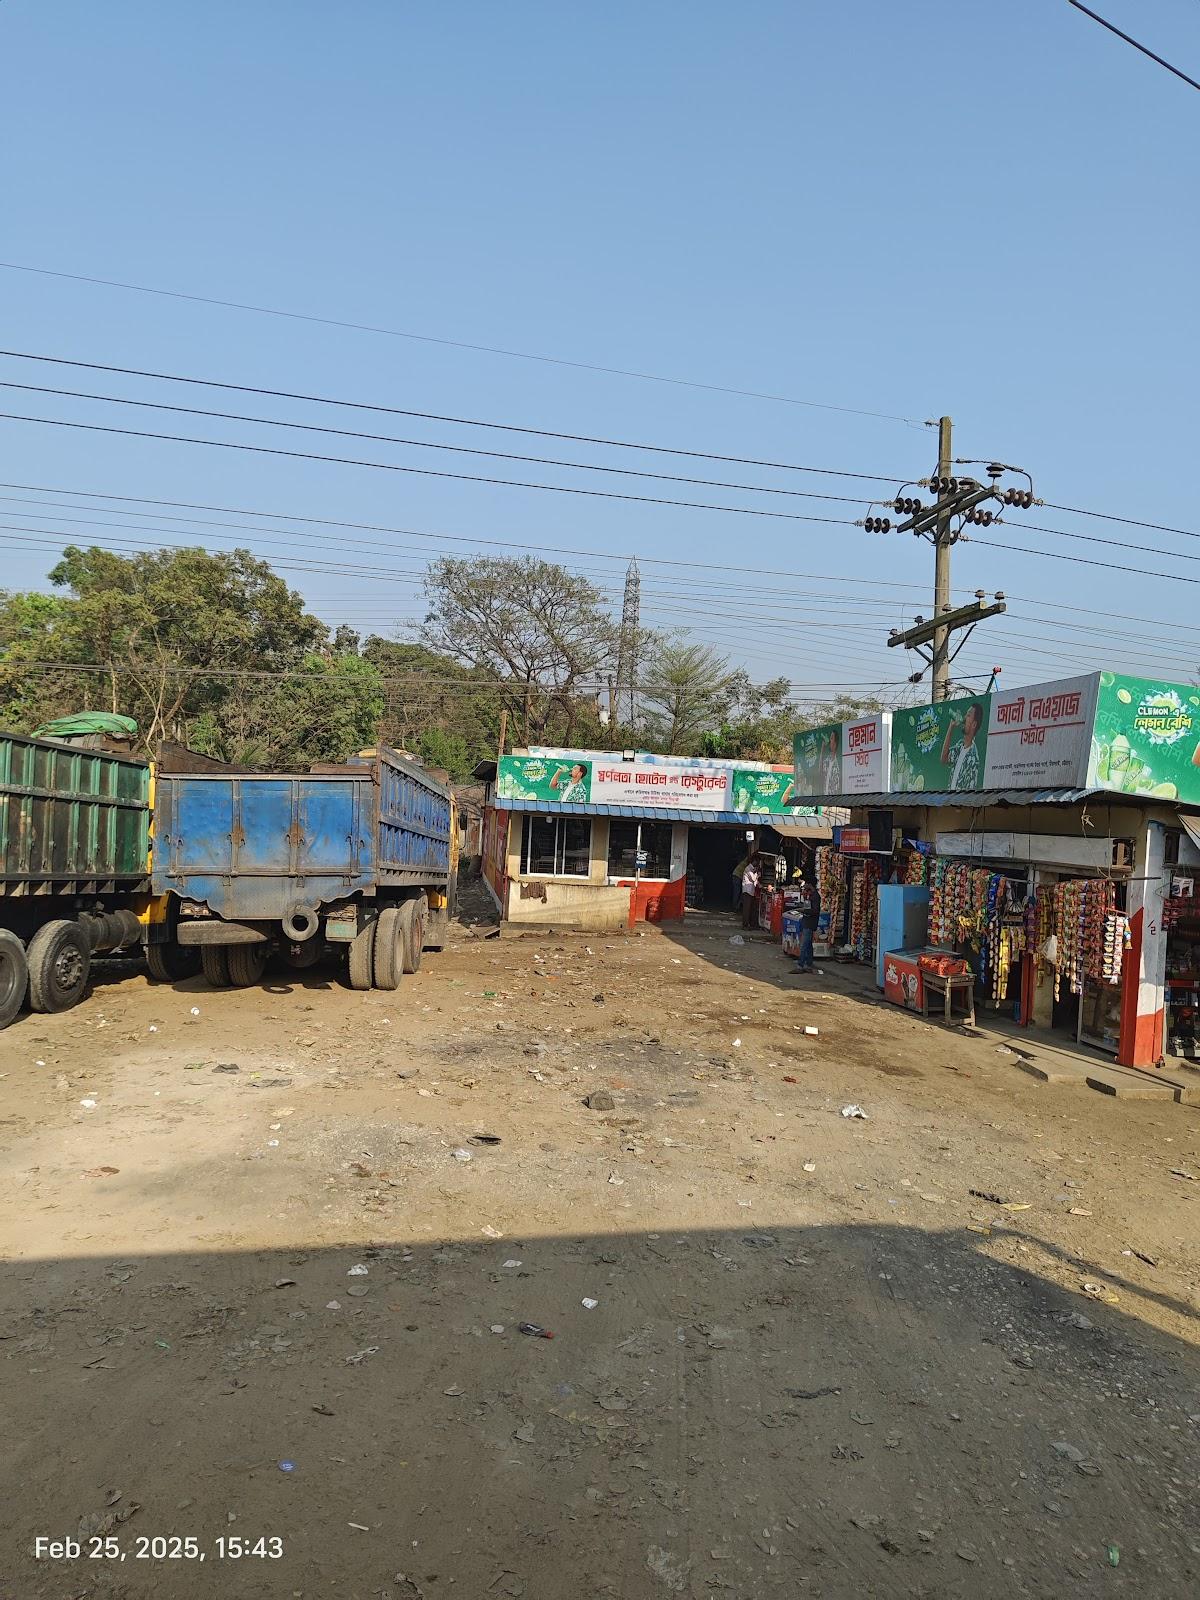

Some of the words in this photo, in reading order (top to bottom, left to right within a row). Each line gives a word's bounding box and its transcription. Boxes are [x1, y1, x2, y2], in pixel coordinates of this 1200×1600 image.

[997, 697, 1025, 724] আলী
[1029, 692, 1081, 721] নেওয়াজ
[1137, 706, 1169, 716] CLEMON
[1133, 717, 1165, 730] লেমন
[1166, 713, 1192, 730] বেশি
[848, 722, 876, 751] রহমান
[1021, 724, 1045, 746] স্টোর
[636, 772, 667, 785] হোটেল
